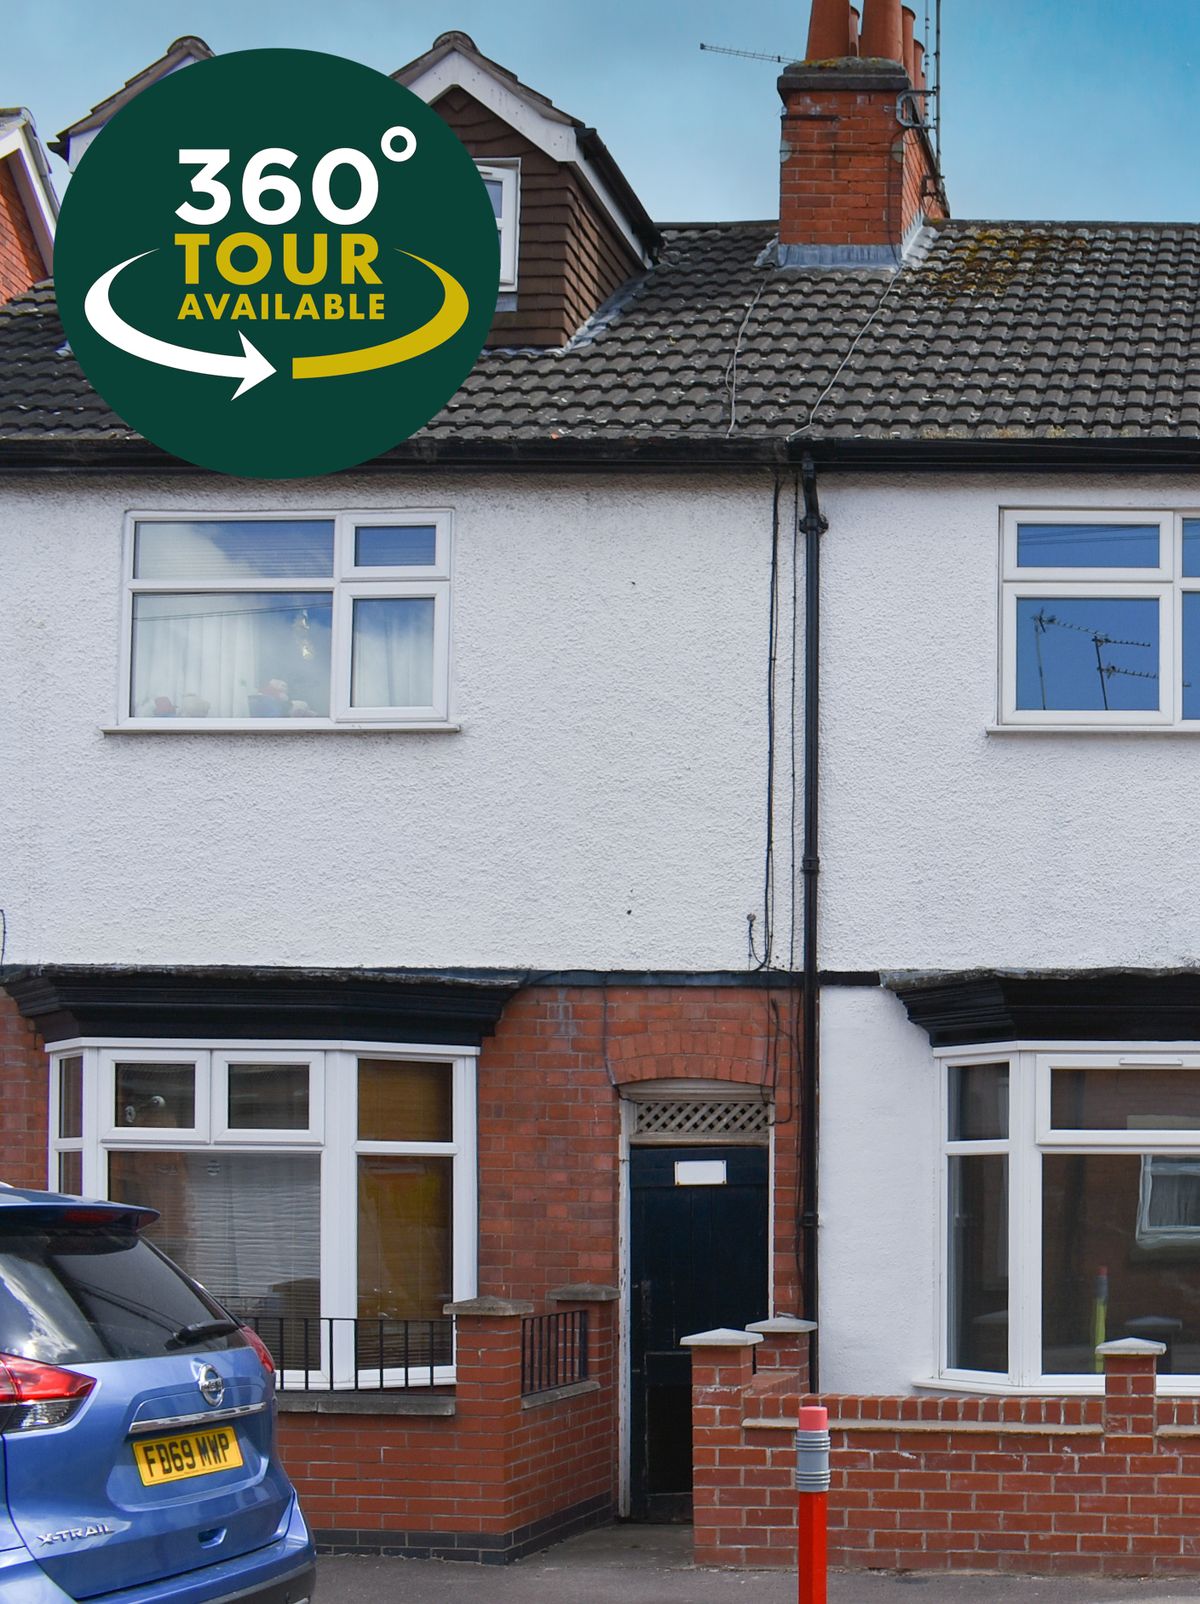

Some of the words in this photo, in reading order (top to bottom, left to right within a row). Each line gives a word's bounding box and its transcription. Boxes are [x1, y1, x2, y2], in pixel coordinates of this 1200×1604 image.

[143, 1439, 196, 1478] FD69
[196, 1432, 230, 1467] MWP
[37, 1524, 114, 1547] X-TRAIL
